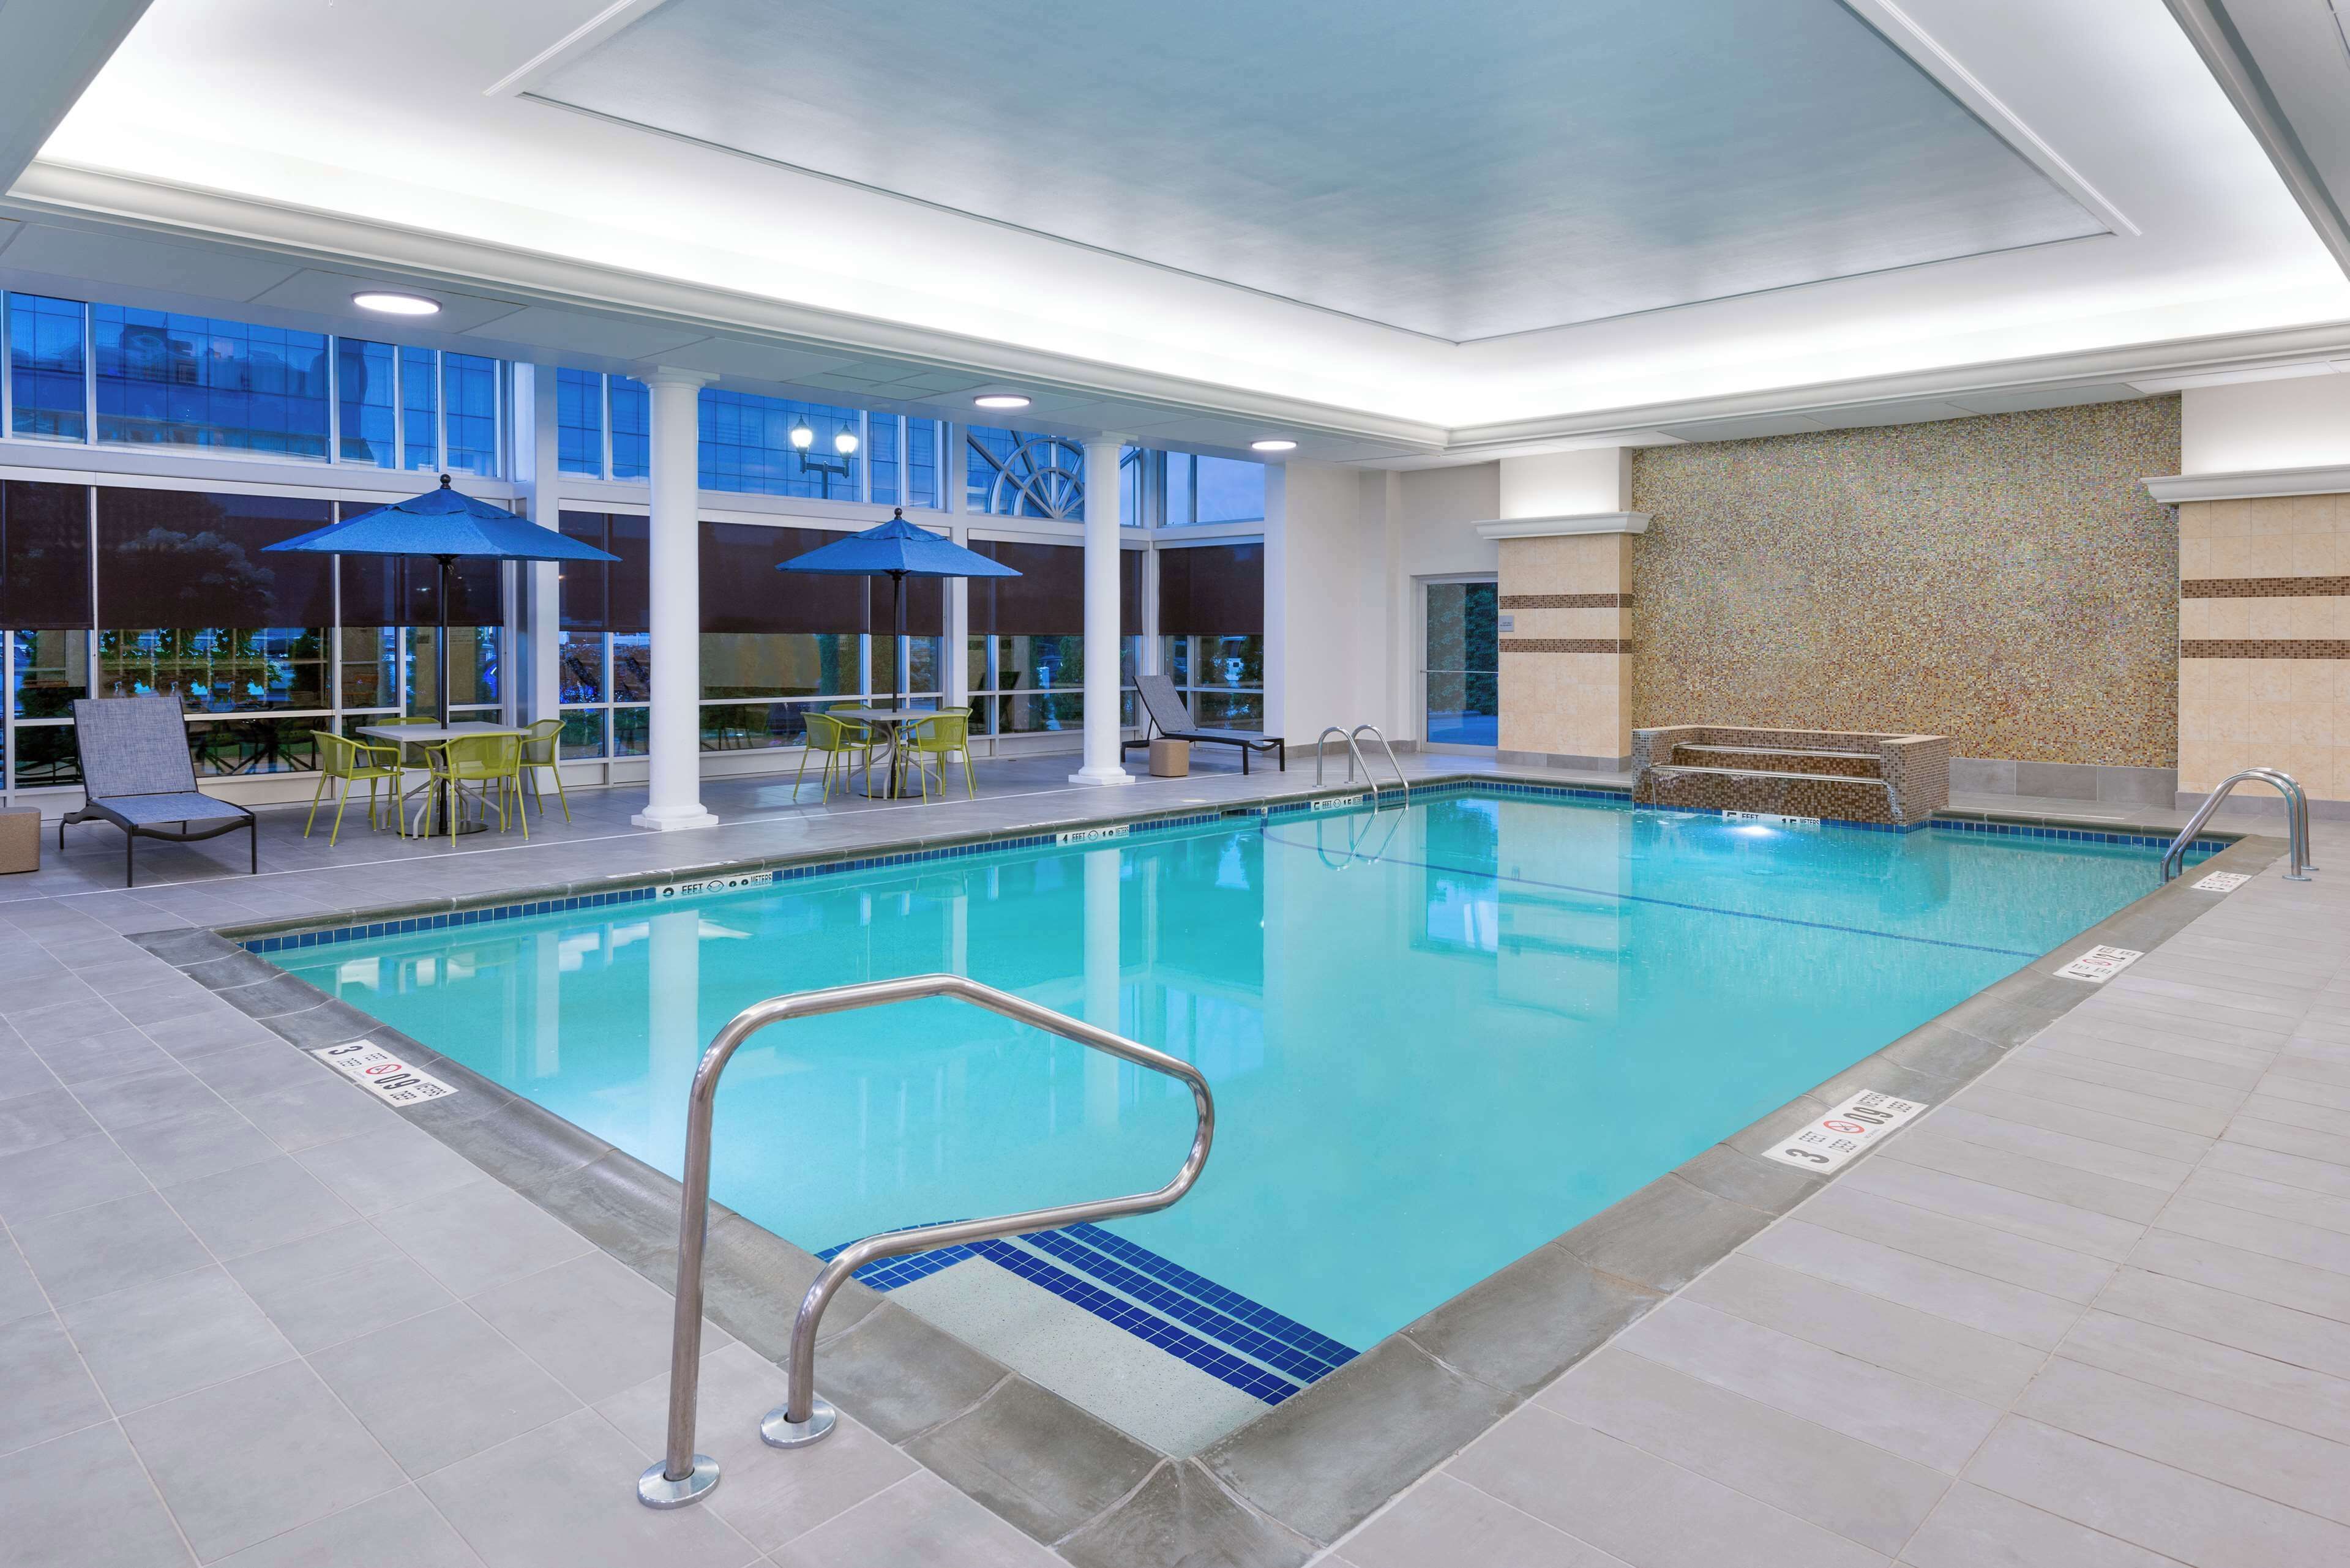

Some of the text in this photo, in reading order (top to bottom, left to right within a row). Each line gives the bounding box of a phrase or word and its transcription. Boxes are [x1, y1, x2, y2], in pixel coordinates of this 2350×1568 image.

[328, 1046, 363, 1055] 3
[1886, 1101, 1912, 1113] DEEP
[1785, 1131, 1830, 1163] 3 FEET
[1828, 1139, 1857, 1153] DEEP
